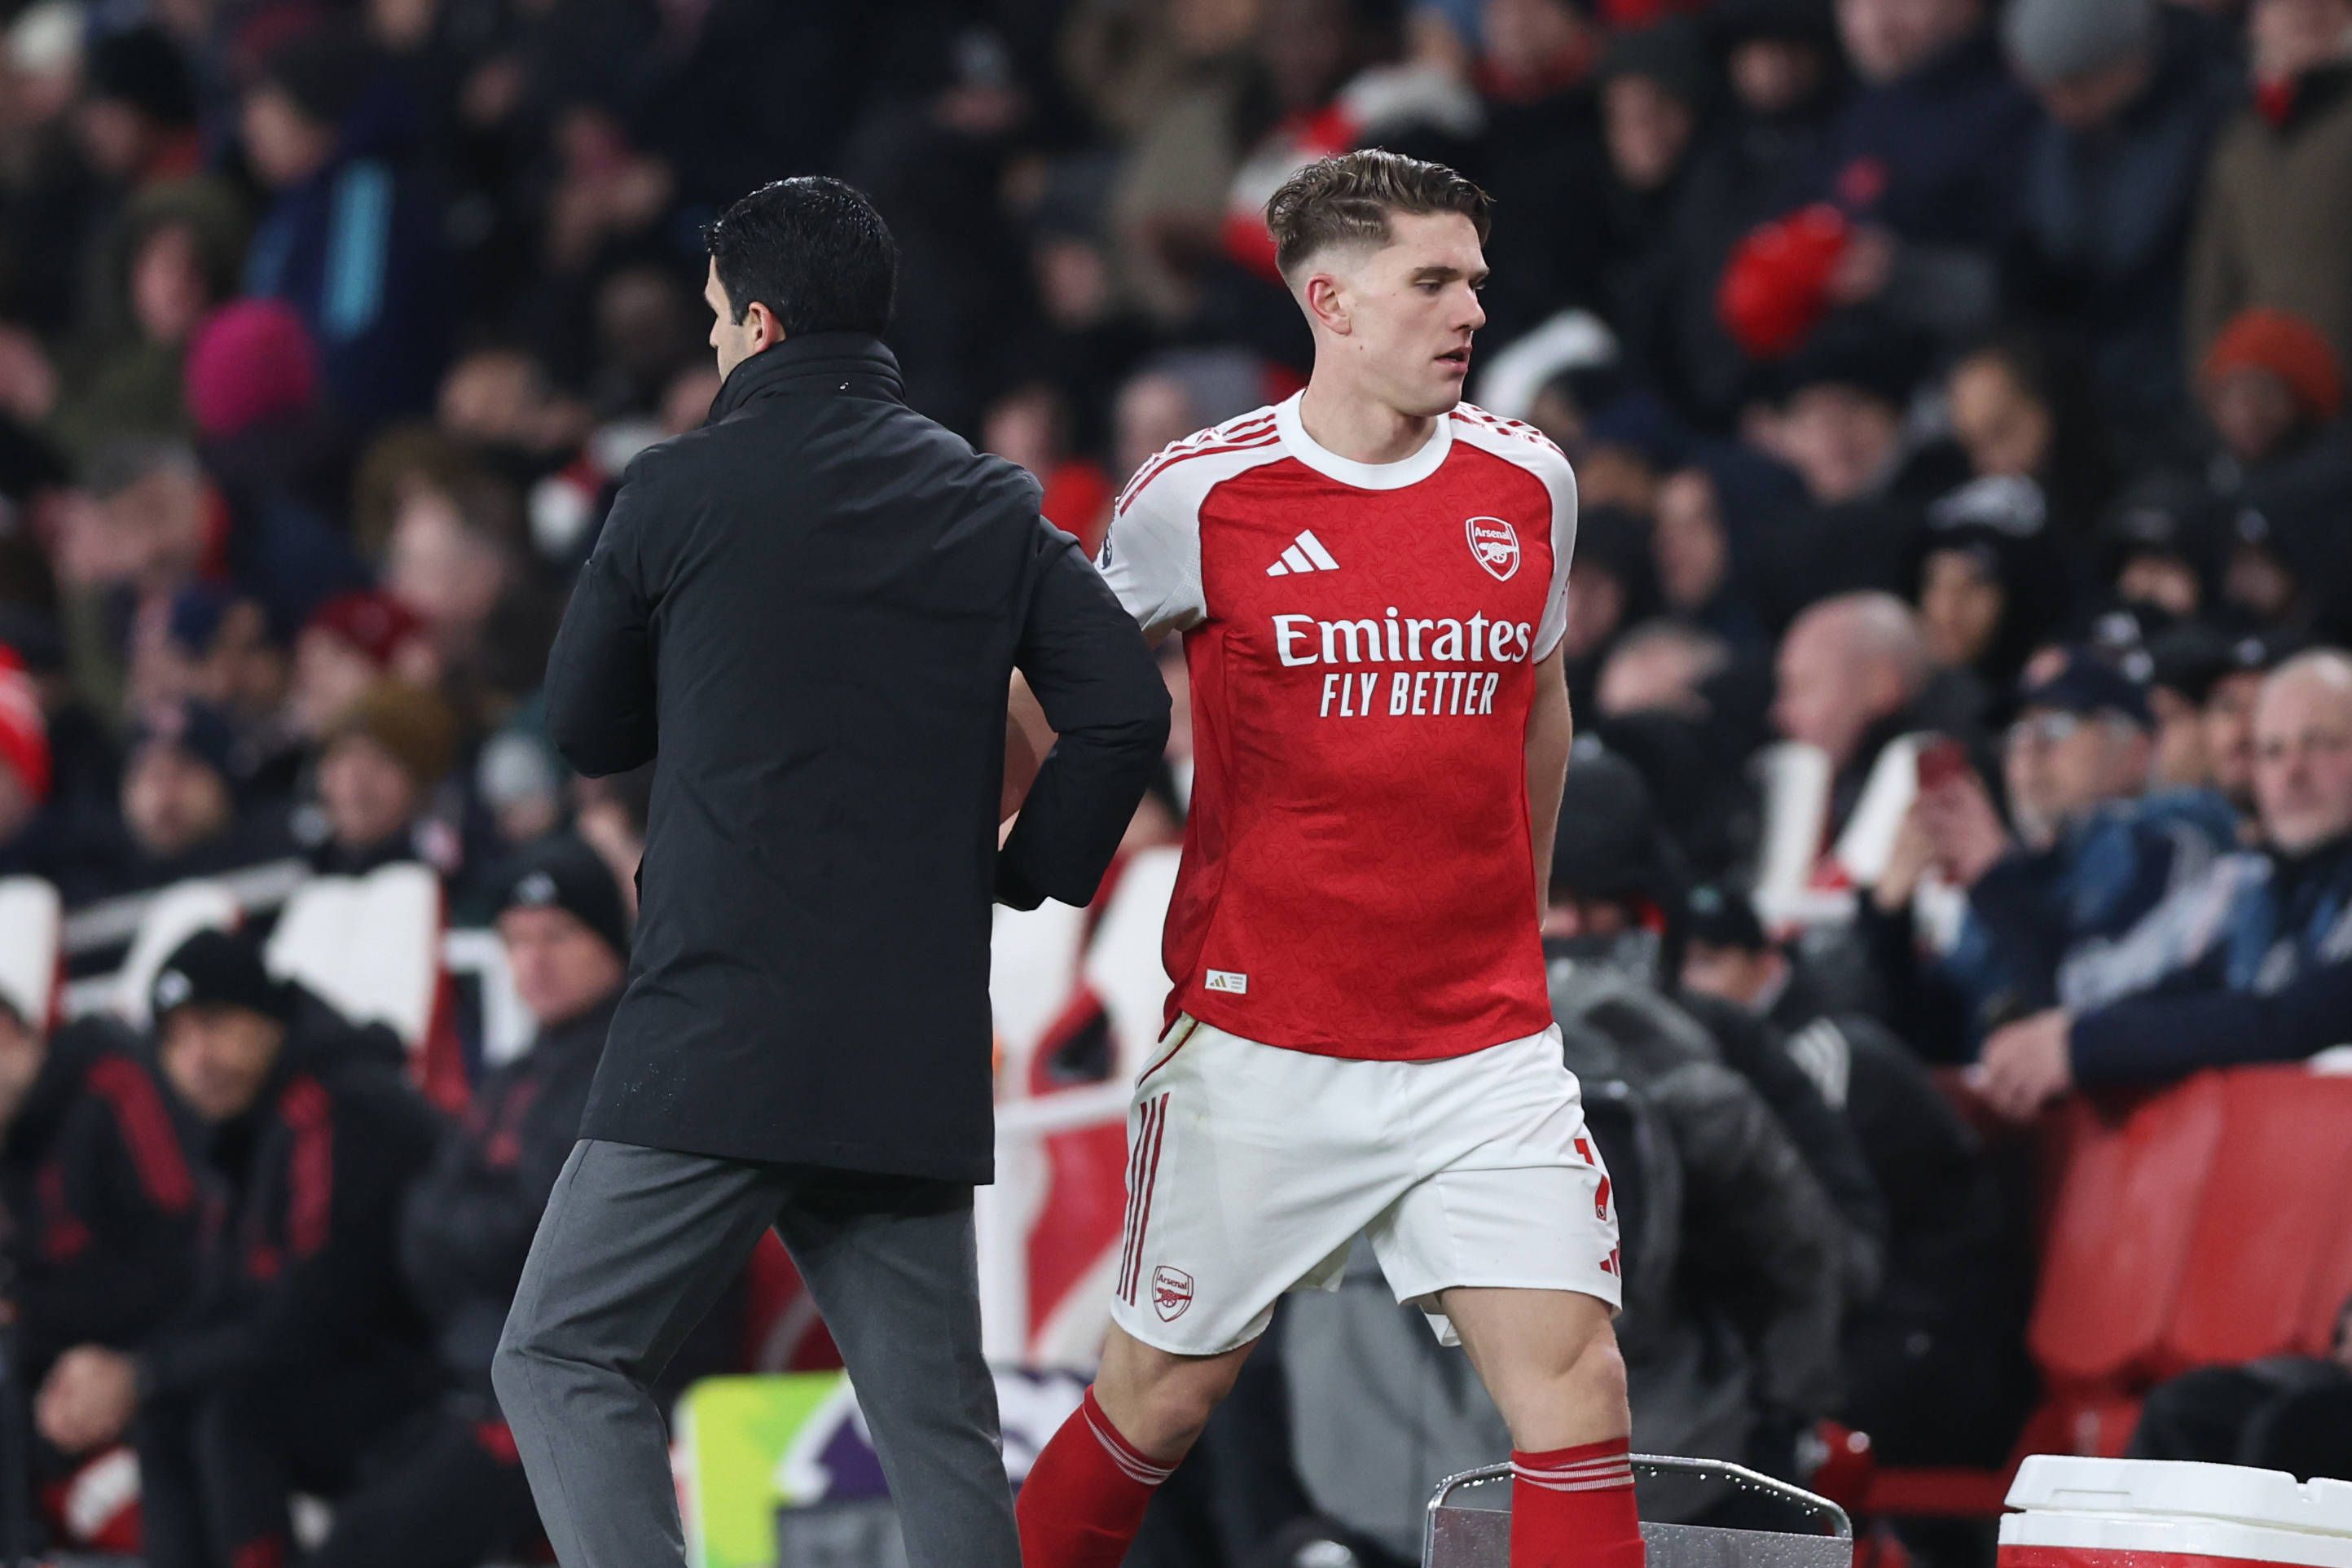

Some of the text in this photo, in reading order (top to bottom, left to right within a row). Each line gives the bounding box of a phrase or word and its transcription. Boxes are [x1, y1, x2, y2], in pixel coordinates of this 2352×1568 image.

[1475, 526, 1510, 540] Arsenal
[1272, 606, 1532, 667] Emirates
[1320, 671, 1500, 718] FLY BETTER
[1157, 1274, 1187, 1289] Arsenal
